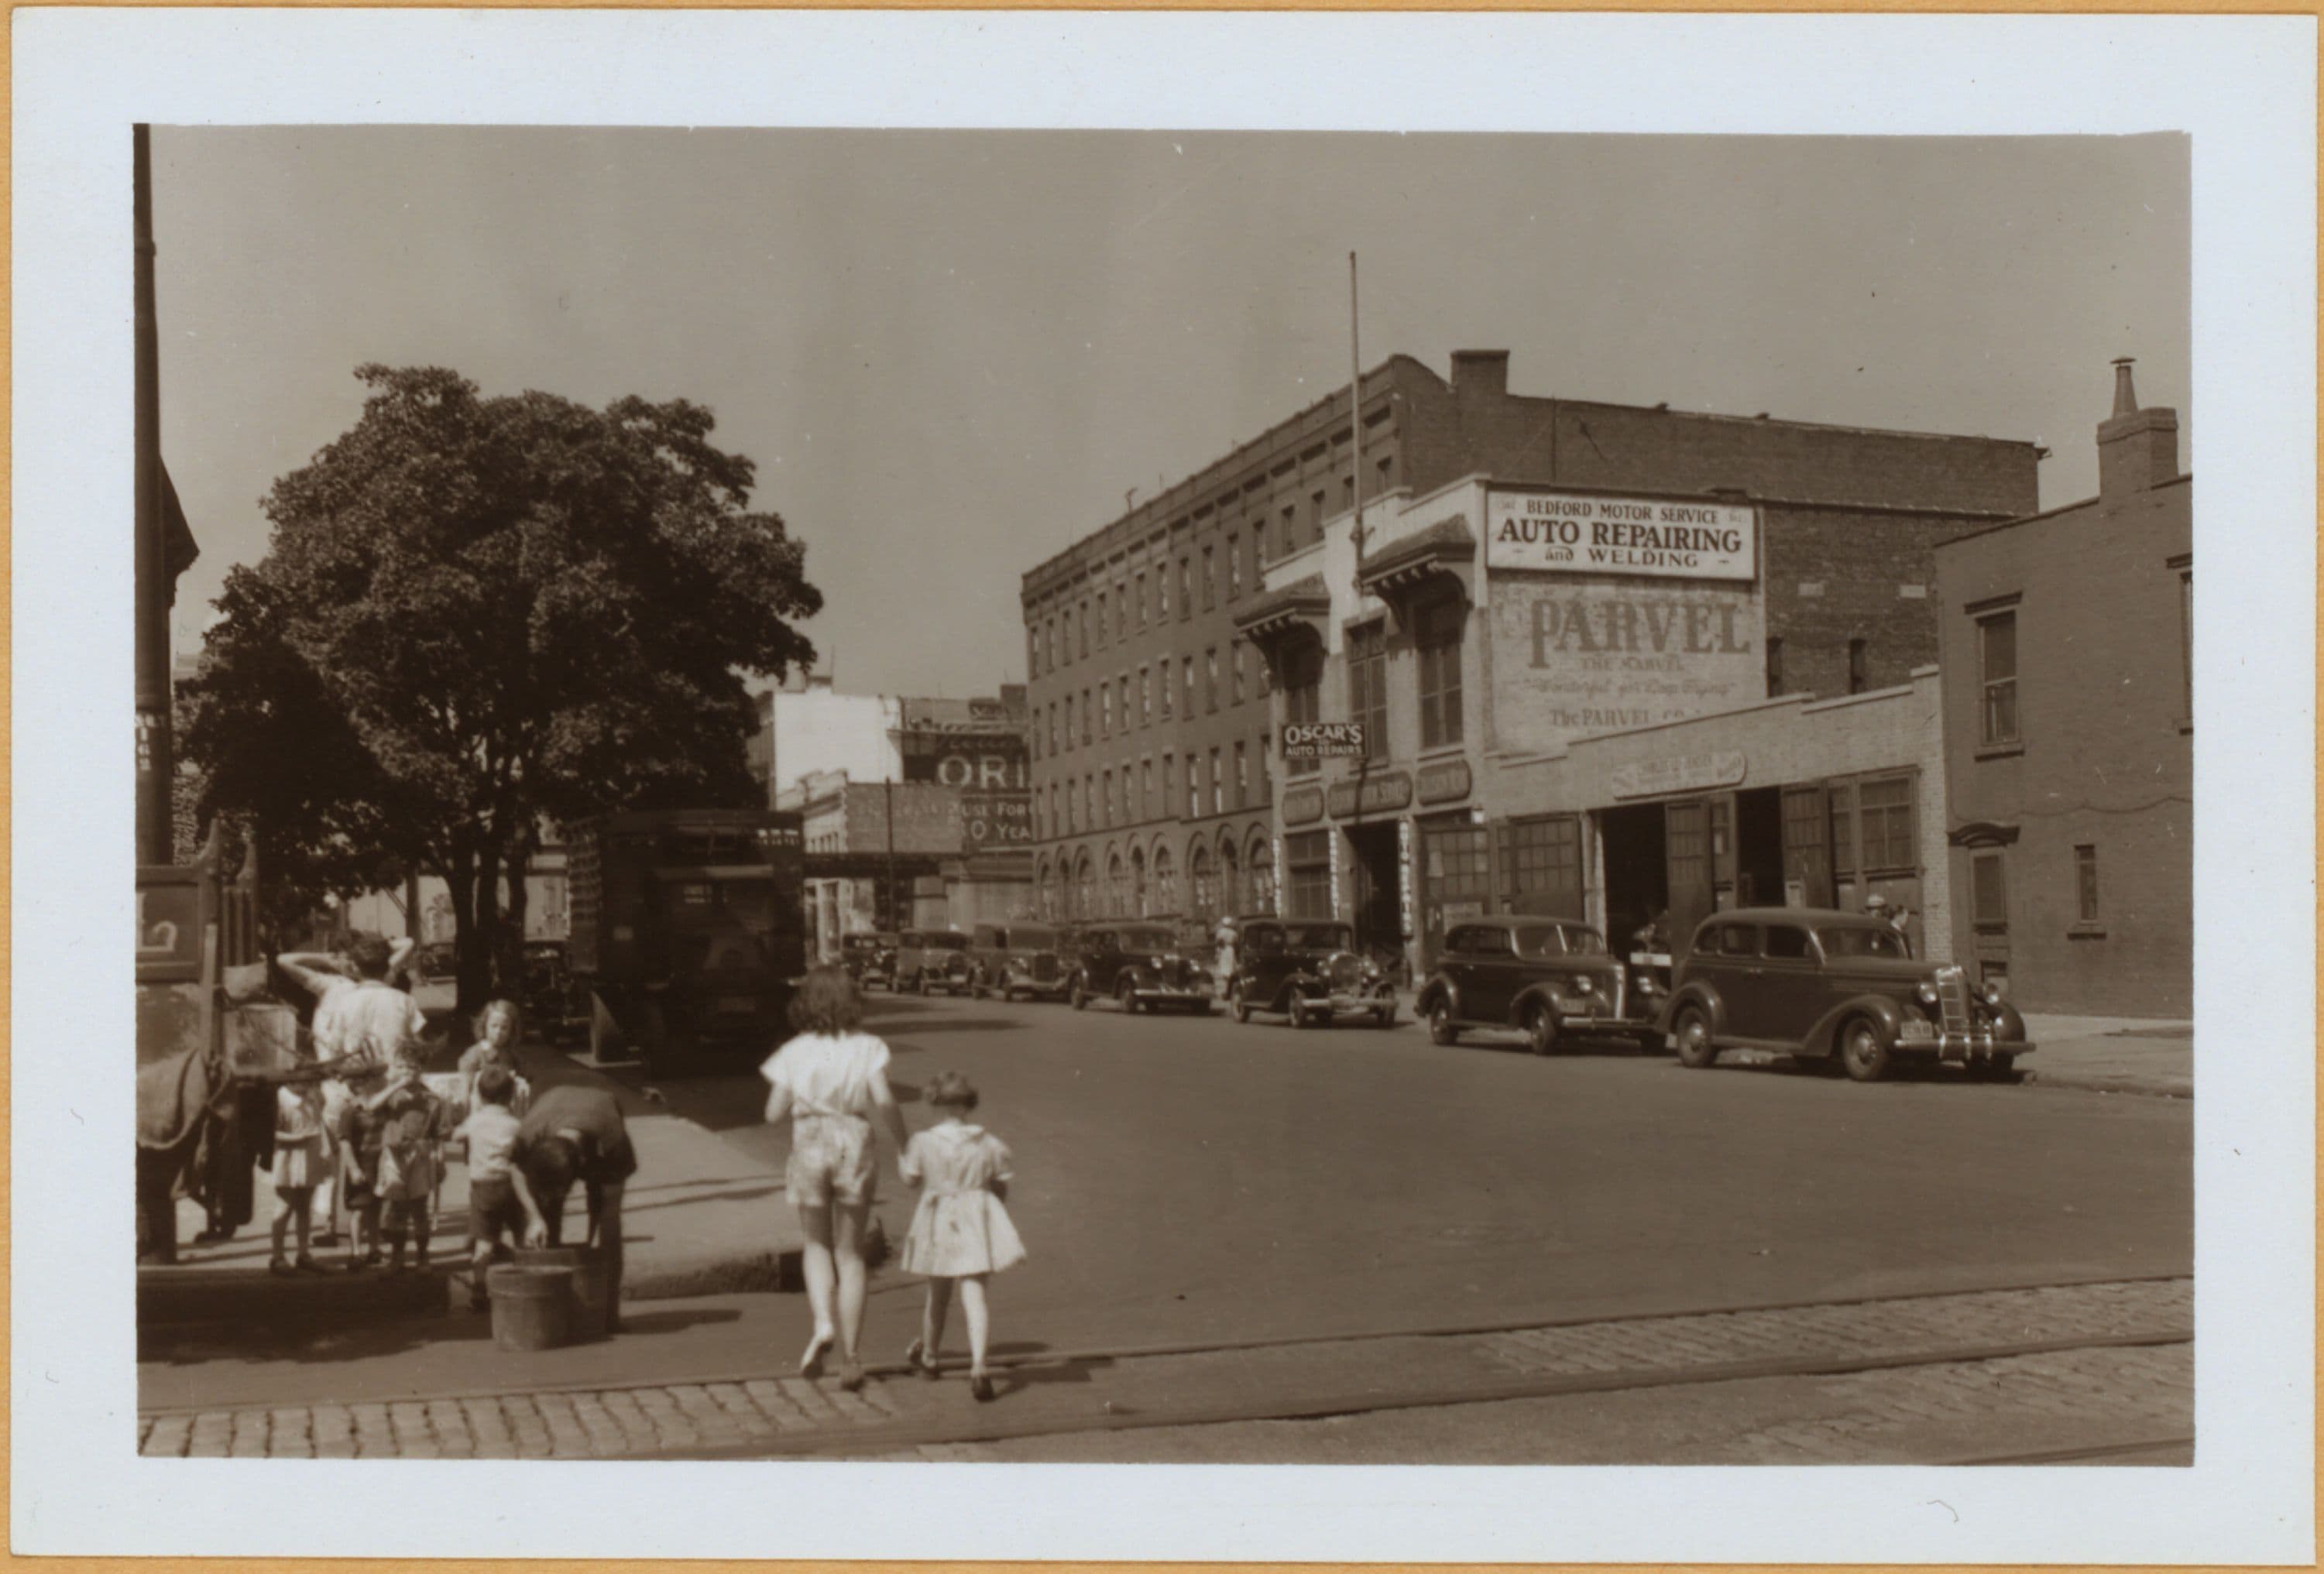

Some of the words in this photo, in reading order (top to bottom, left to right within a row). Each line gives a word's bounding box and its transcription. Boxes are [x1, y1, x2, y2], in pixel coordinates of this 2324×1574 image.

[1526, 499, 1591, 516] BEDFORD
[1599, 503, 1652, 520] MOTOR
[1660, 507, 1718, 524] SERVICE
[1498, 517, 1581, 544] AUTO
[1591, 522, 1742, 553] REPAIRING
[1545, 545, 1574, 562] and
[1588, 547, 1698, 568] WELDING
[1528, 599, 1750, 669] PARVEL
[1285, 725, 1362, 744] OSCAR'S
[1286, 745, 1315, 756] AUTO
[1317, 744, 1362, 756] REPAIRS
